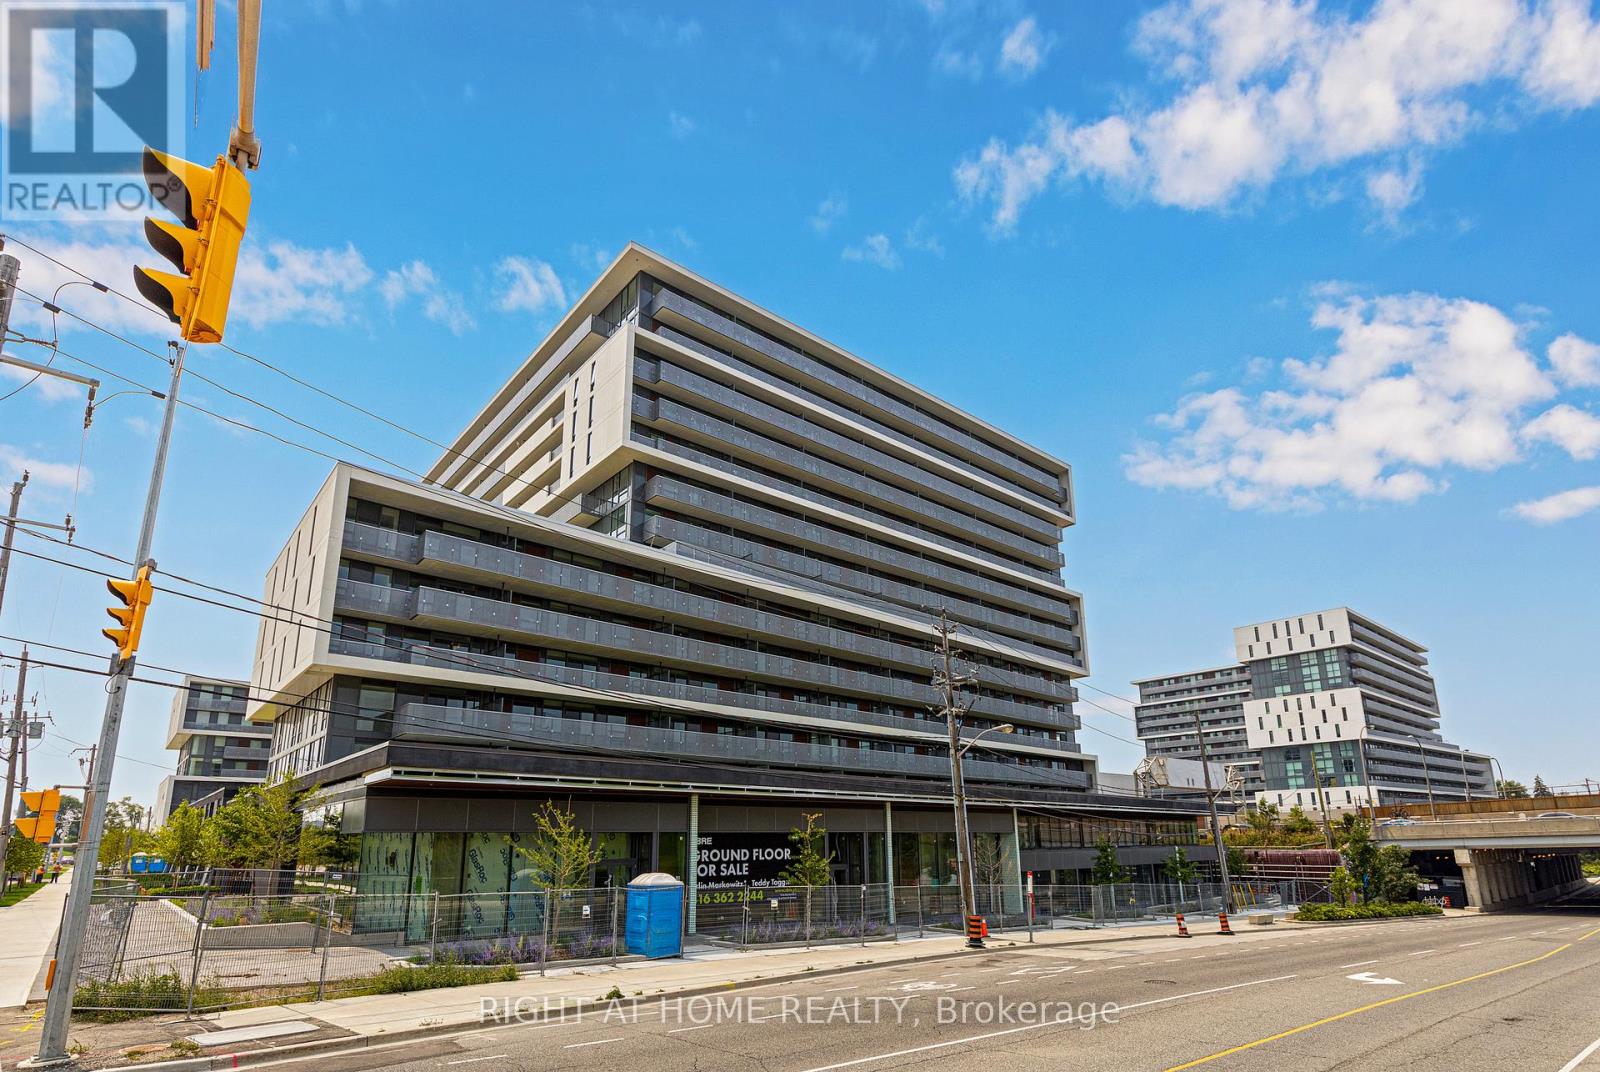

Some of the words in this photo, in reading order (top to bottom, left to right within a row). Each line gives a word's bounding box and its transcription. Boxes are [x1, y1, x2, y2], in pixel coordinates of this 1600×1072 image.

[696, 837, 713, 845] BRE
[752, 848, 792, 861] FLOOR
[697, 863, 717, 877] OR
[720, 863, 750, 876] SALE
[698, 893, 711, 905] 16
[713, 892, 734, 904] 362
[737, 890, 764, 902] 244
